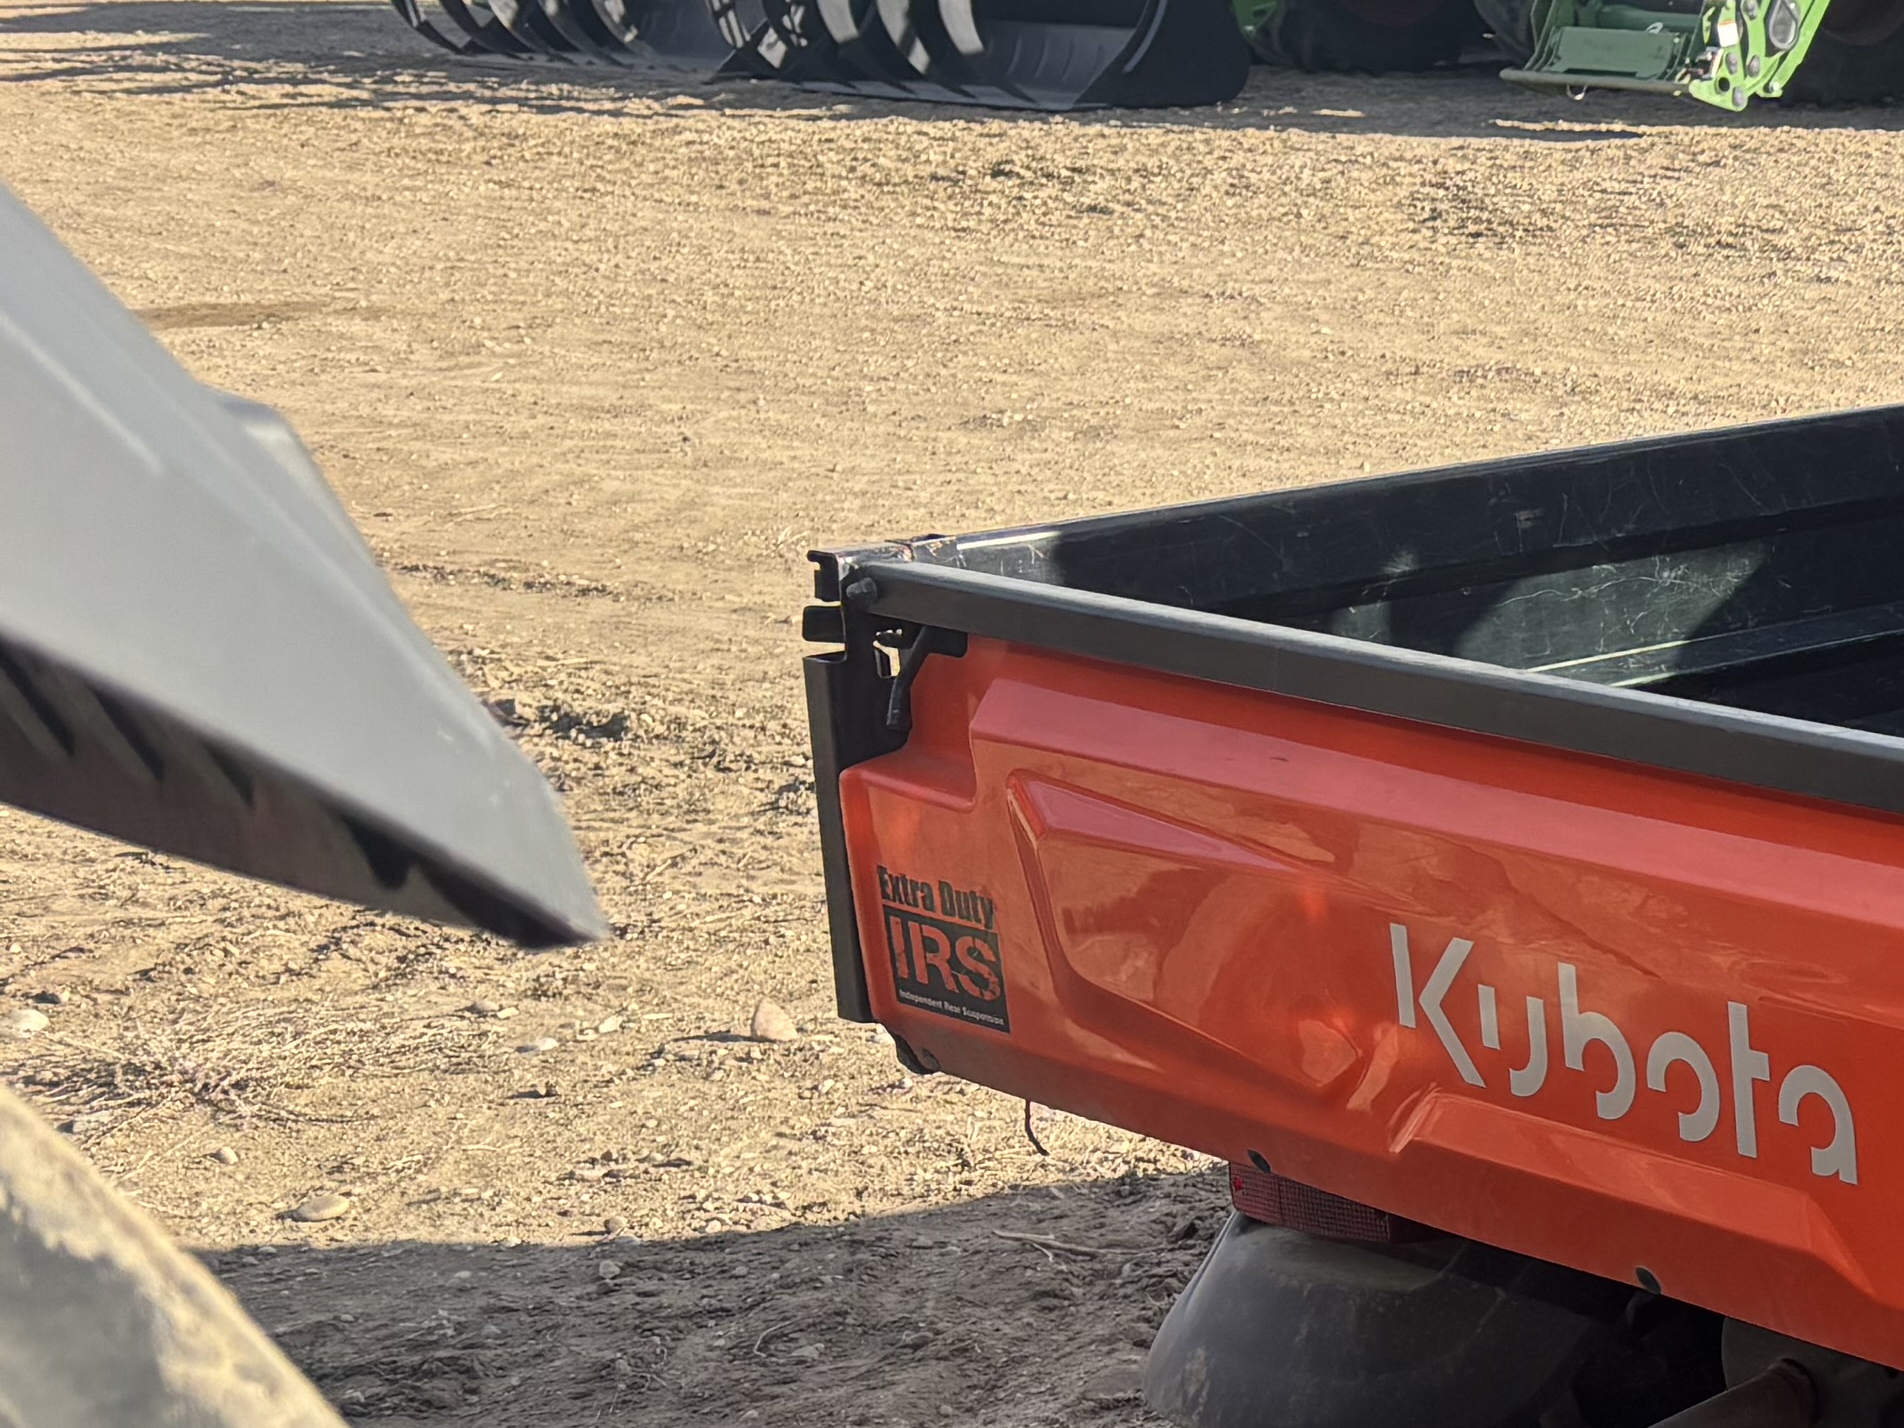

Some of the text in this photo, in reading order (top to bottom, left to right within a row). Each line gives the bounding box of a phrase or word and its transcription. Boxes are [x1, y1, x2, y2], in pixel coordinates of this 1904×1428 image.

[877, 865, 995, 932] Extra Duty
[888, 914, 1001, 1002] IRS
[898, 987, 943, 1011] Independent
[1389, 922, 1858, 1186] Kubota
